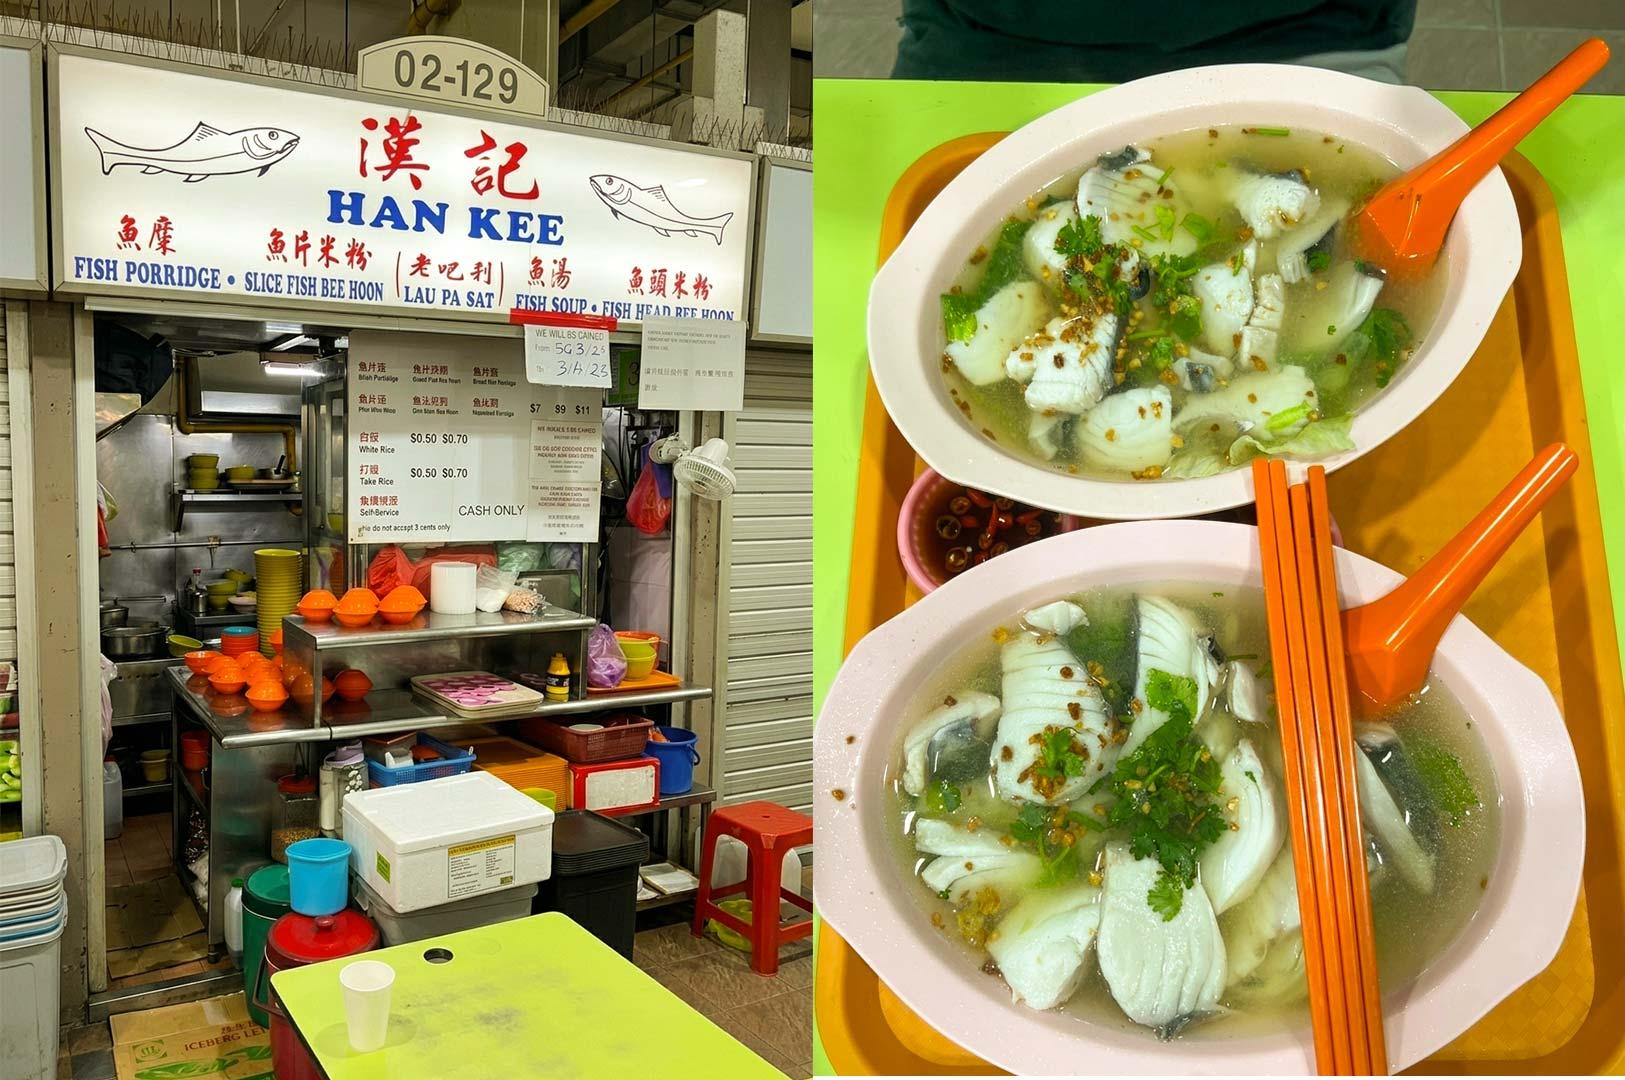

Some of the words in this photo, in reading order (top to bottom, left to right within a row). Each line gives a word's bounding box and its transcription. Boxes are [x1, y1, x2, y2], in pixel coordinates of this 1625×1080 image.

[394, 50, 518, 104] 02-129
[327, 189, 449, 234] HAN
[468, 206, 564, 246] KEE
[265, 227, 373, 272] 魚片米粉
[74, 256, 118, 281] FISH
[125, 261, 221, 290] PORRIDGE
[527, 255, 572, 290] 魚湯
[244, 271, 283, 294] SLICE
[287, 274, 318, 297] FISH
[321, 278, 345, 299] BEE
[349, 280, 384, 302] HOON
[627, 265, 713, 301] 魚頭米粉
[403, 286, 436, 305] LAU
[441, 289, 461, 306] PA
[466, 291, 495, 309] SAT
[515, 293, 547, 312] FISH
[551, 296, 587, 313] SOUP
[602, 301, 631, 320] FISH
[535, 329, 548, 338] WE
[549, 330, 566, 339] WILL
[410, 432, 437, 444] $0.50
[442, 433, 468, 445] $0.70
[359, 446, 378, 454] White
[360, 478, 377, 486] Take
[378, 478, 394, 486] Rice
[410, 468, 437, 479] $0.50
[442, 467, 468, 479] $0.70
[458, 505, 491, 516] CASH
[493, 505, 525, 516] ONLY
[184, 1033, 241, 1051] ICEBERG
